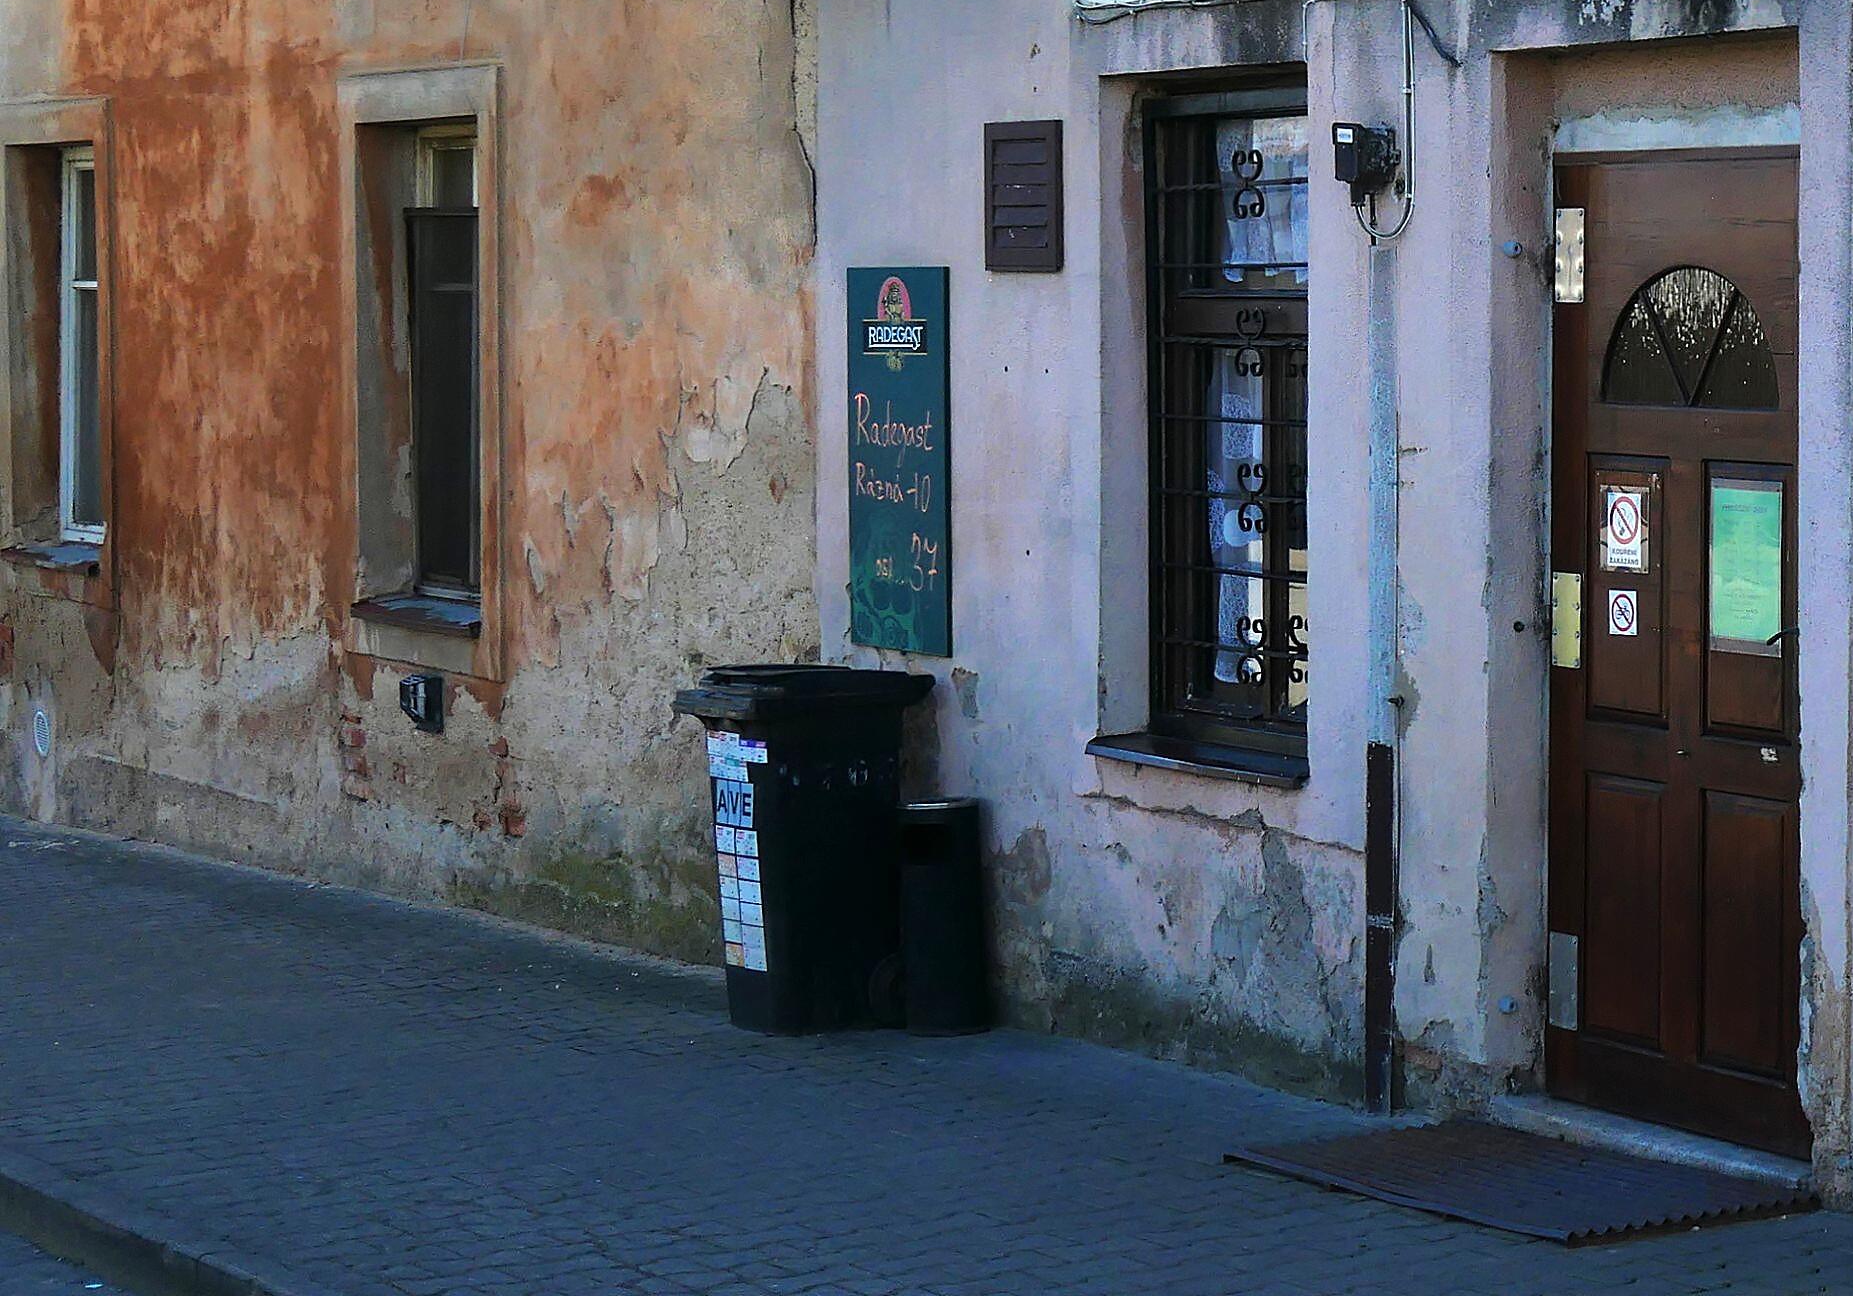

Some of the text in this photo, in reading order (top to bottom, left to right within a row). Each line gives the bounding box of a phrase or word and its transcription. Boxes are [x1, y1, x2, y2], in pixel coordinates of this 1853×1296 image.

[868, 326, 923, 350] RADEGAST
[854, 392, 934, 468] Radegast
[717, 789, 752, 817] AVE
